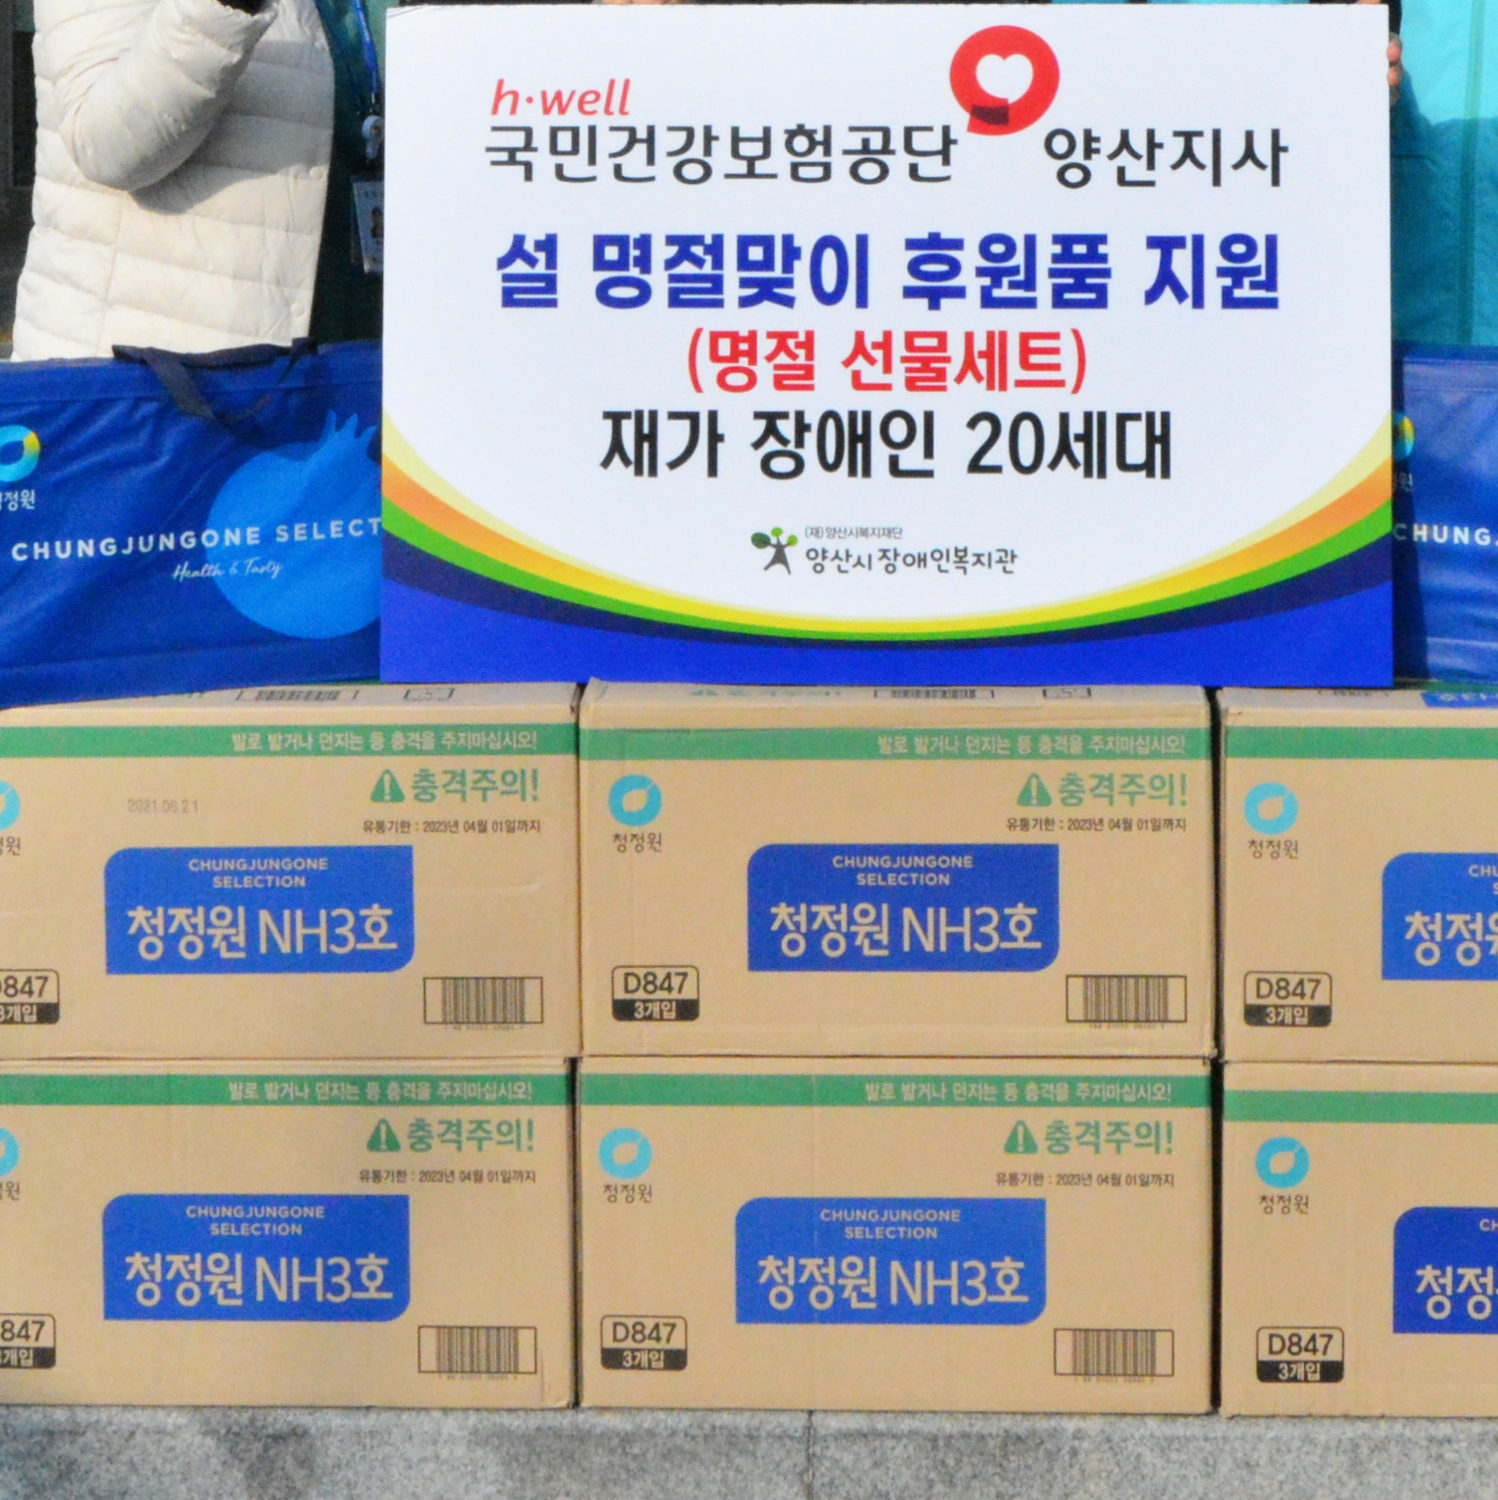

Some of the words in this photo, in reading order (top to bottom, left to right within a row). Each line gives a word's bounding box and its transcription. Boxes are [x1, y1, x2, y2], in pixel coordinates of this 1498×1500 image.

[484, 123, 959, 185] 국민건강보험공단
[1043, 126, 1289, 189] 양산지사
[495, 233, 559, 310] 설
[592, 233, 871, 310] 명절맞이
[902, 233, 1110, 310] 후원품
[1144, 233, 1281, 310] 지원
[687, 325, 817, 394] (명절
[842, 325, 1088, 394] 선물세트)
[600, 409, 724, 480] 재가
[750, 409, 936, 480] 장애인
[965, 410, 1172, 480] 20세대
[11, 527, 260, 562] CHUNGJUNGONE
[412, 768, 539, 802] 충격주의!
[1059, 773, 1187, 807] 충격주의!
[613, 832, 663, 853] 청정원
[1248, 839, 1299, 860] 청정원
[188, 857, 329, 873] CHUNGJUNGONE
[832, 855, 973, 870] CHUNGJUNGONE
[213, 875, 306, 888] SELECTION
[857, 872, 950, 886] SELECTION
[128, 904, 246, 960] 청정원
[260, 903, 398, 955] NH3호
[770, 902, 890, 957] 청정원
[903, 902, 1042, 953] NH3호
[623, 972, 688, 995] D847
[1256, 978, 1321, 1001] D847
[634, 1001, 677, 1019] 3개입
[1265, 1006, 1308, 1025] 3개입
[407, 1118, 534, 1152] 충격주의!
[1045, 1120, 1173, 1154] 충격주의!
[603, 1183, 653, 1204] 청정원
[1259, 1194, 1309, 1214] 청정원
[186, 1205, 325, 1219] CHUNGJUNGONE
[820, 1208, 961, 1223] CHUNGJUNGONE
[210, 1223, 302, 1236] SELECTION
[845, 1226, 938, 1239] SELECTION
[125, 1252, 243, 1307] 청정원
[255, 1251, 393, 1302] NH3호
[759, 1255, 877, 1310] 청정원
[890, 1253, 1029, 1306] NH3호
[612, 1322, 676, 1345] D847
[1268, 1333, 1333, 1356] D847
[622, 1350, 665, 1369] 3개입
[1278, 1362, 1321, 1380] 3개입
